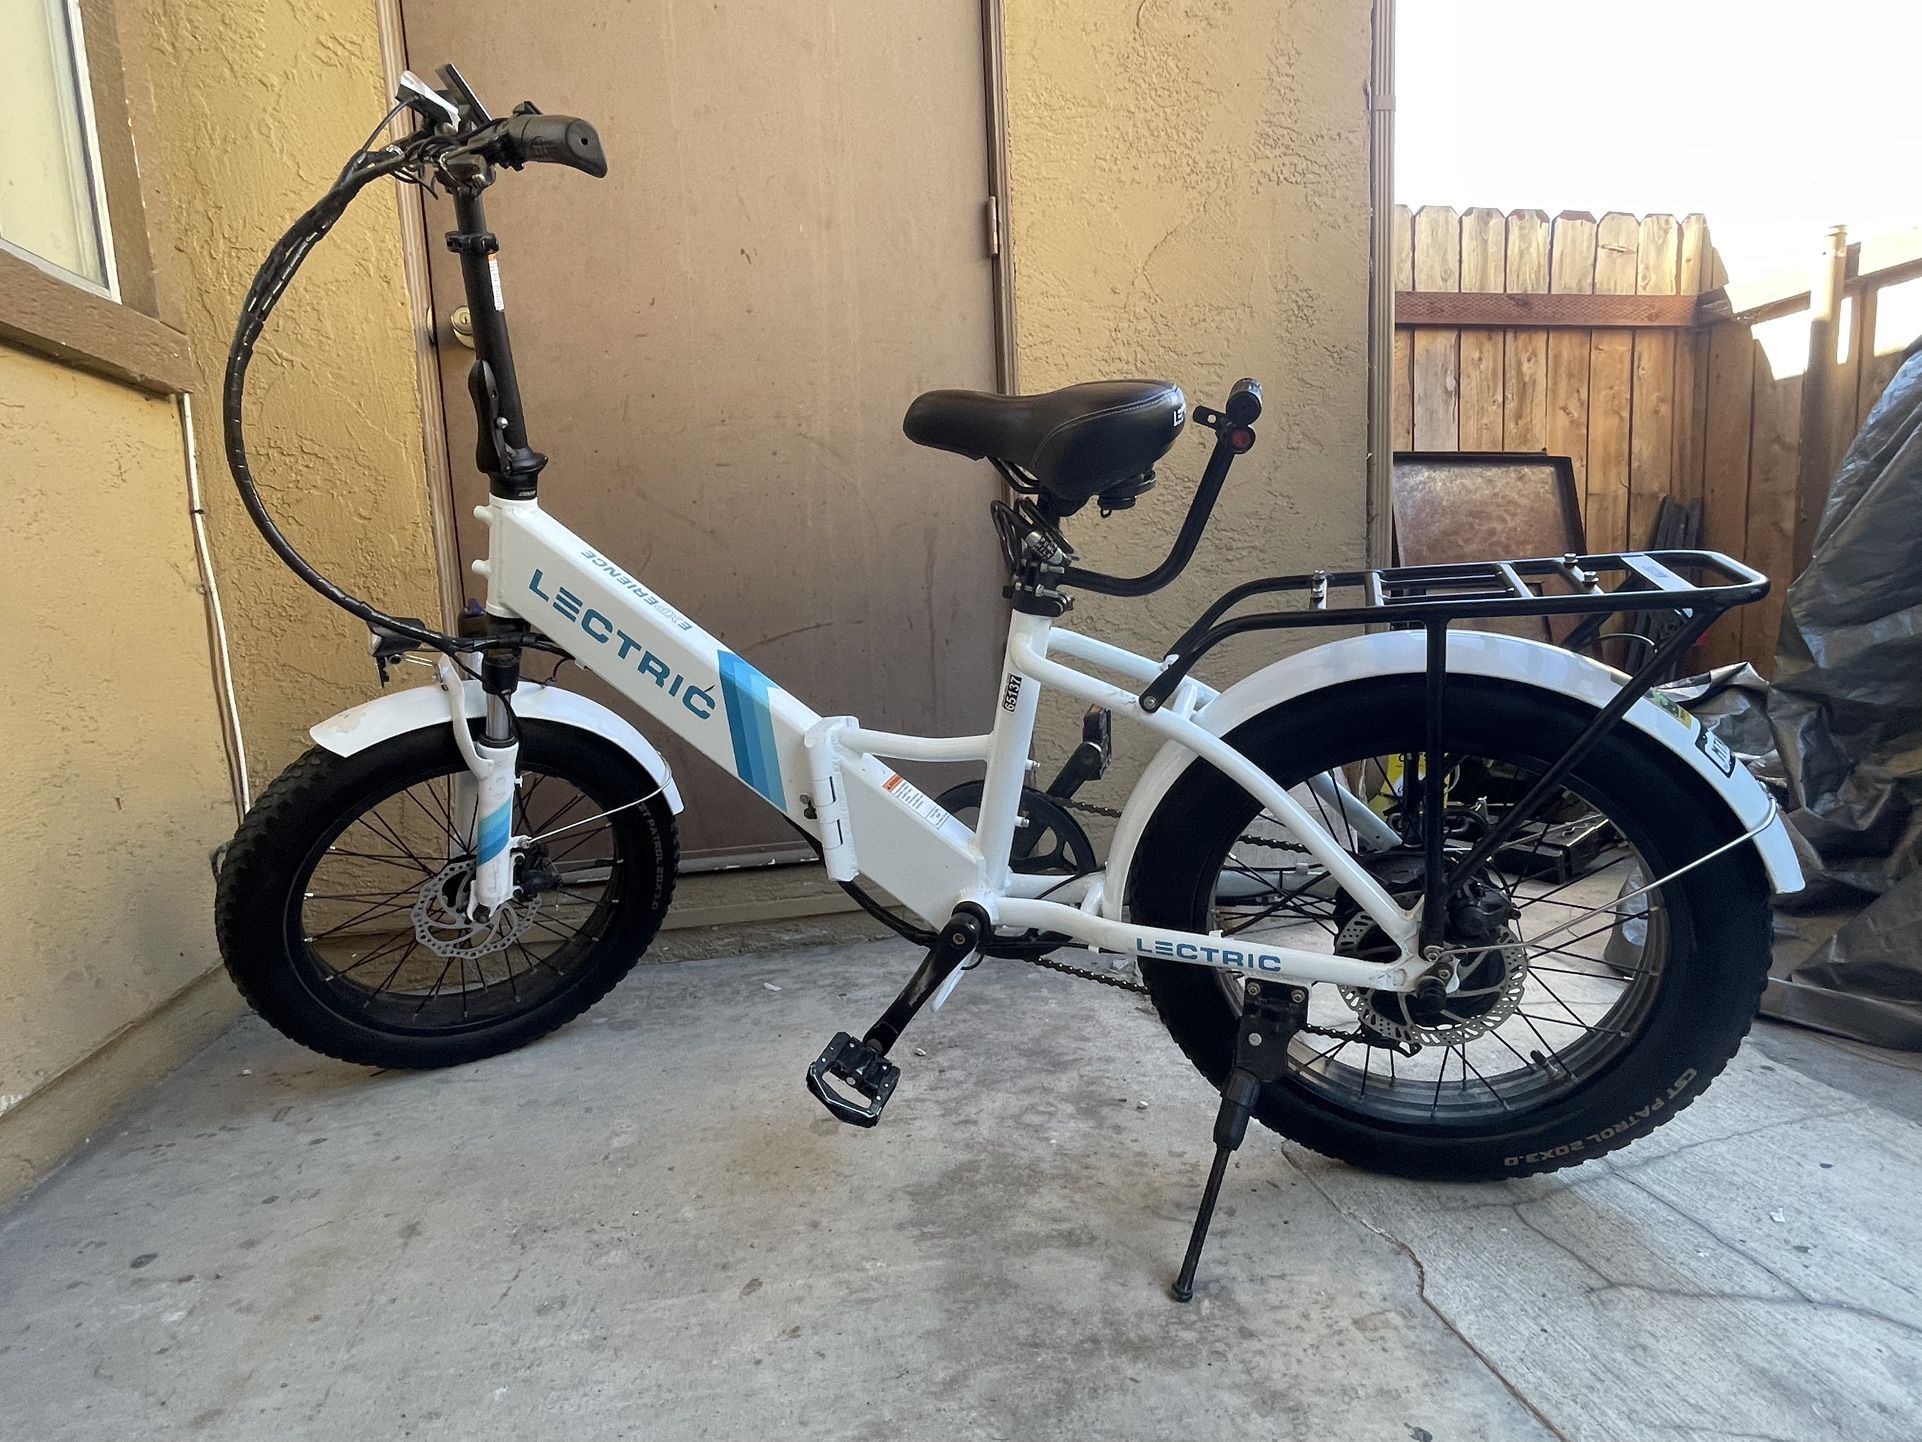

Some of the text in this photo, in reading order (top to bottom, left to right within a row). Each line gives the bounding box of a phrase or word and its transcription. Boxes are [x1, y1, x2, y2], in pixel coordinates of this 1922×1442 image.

[528, 568, 716, 720] LECTRIC
[1003, 675, 1021, 712] 65137
[1136, 937, 1282, 972] LECTRIC
[1666, 1067, 1698, 1100] CST
[1586, 1097, 1665, 1143] PATROL
